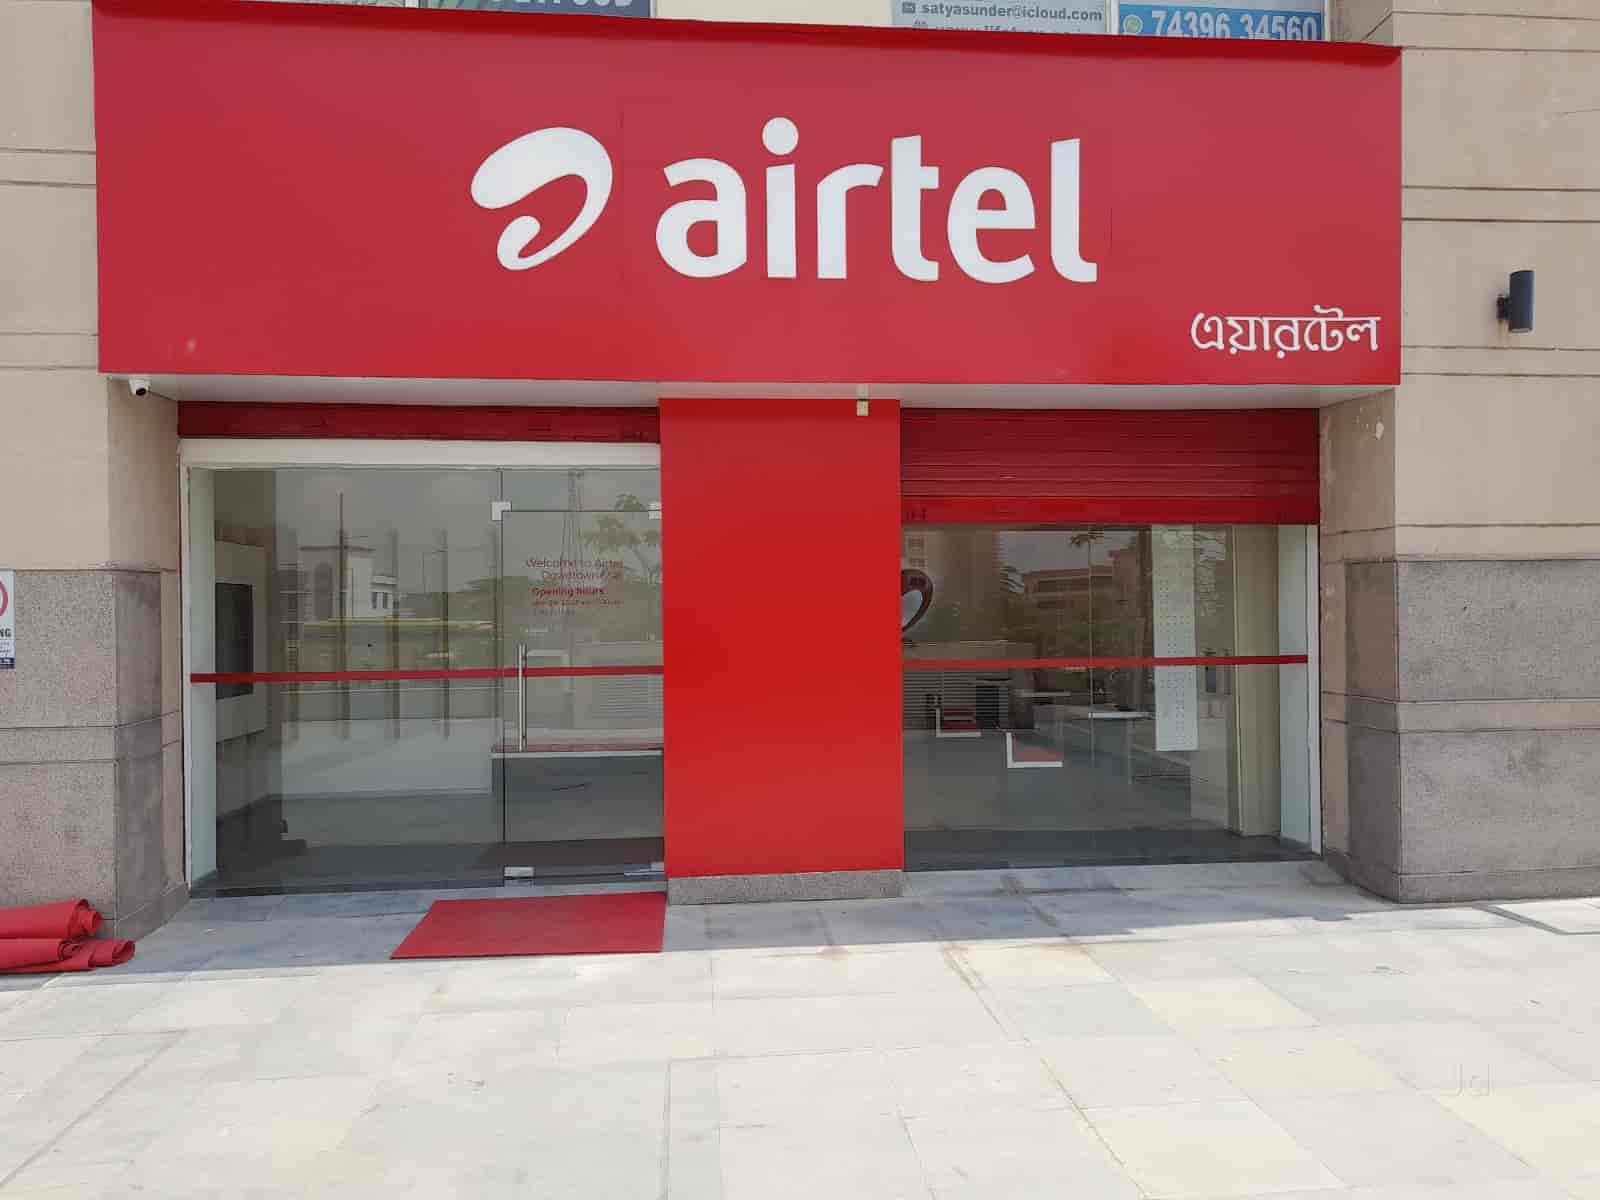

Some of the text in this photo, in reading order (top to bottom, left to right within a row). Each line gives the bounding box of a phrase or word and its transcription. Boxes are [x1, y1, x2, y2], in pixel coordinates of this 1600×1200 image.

[922, 2, 1103, 21] satyasunder@icloud.com
[1151, 10, 1317, 40] 74396 34560
[656, 117, 1097, 283] airtel
[1191, 304, 1381, 359] এয়ারটেল
